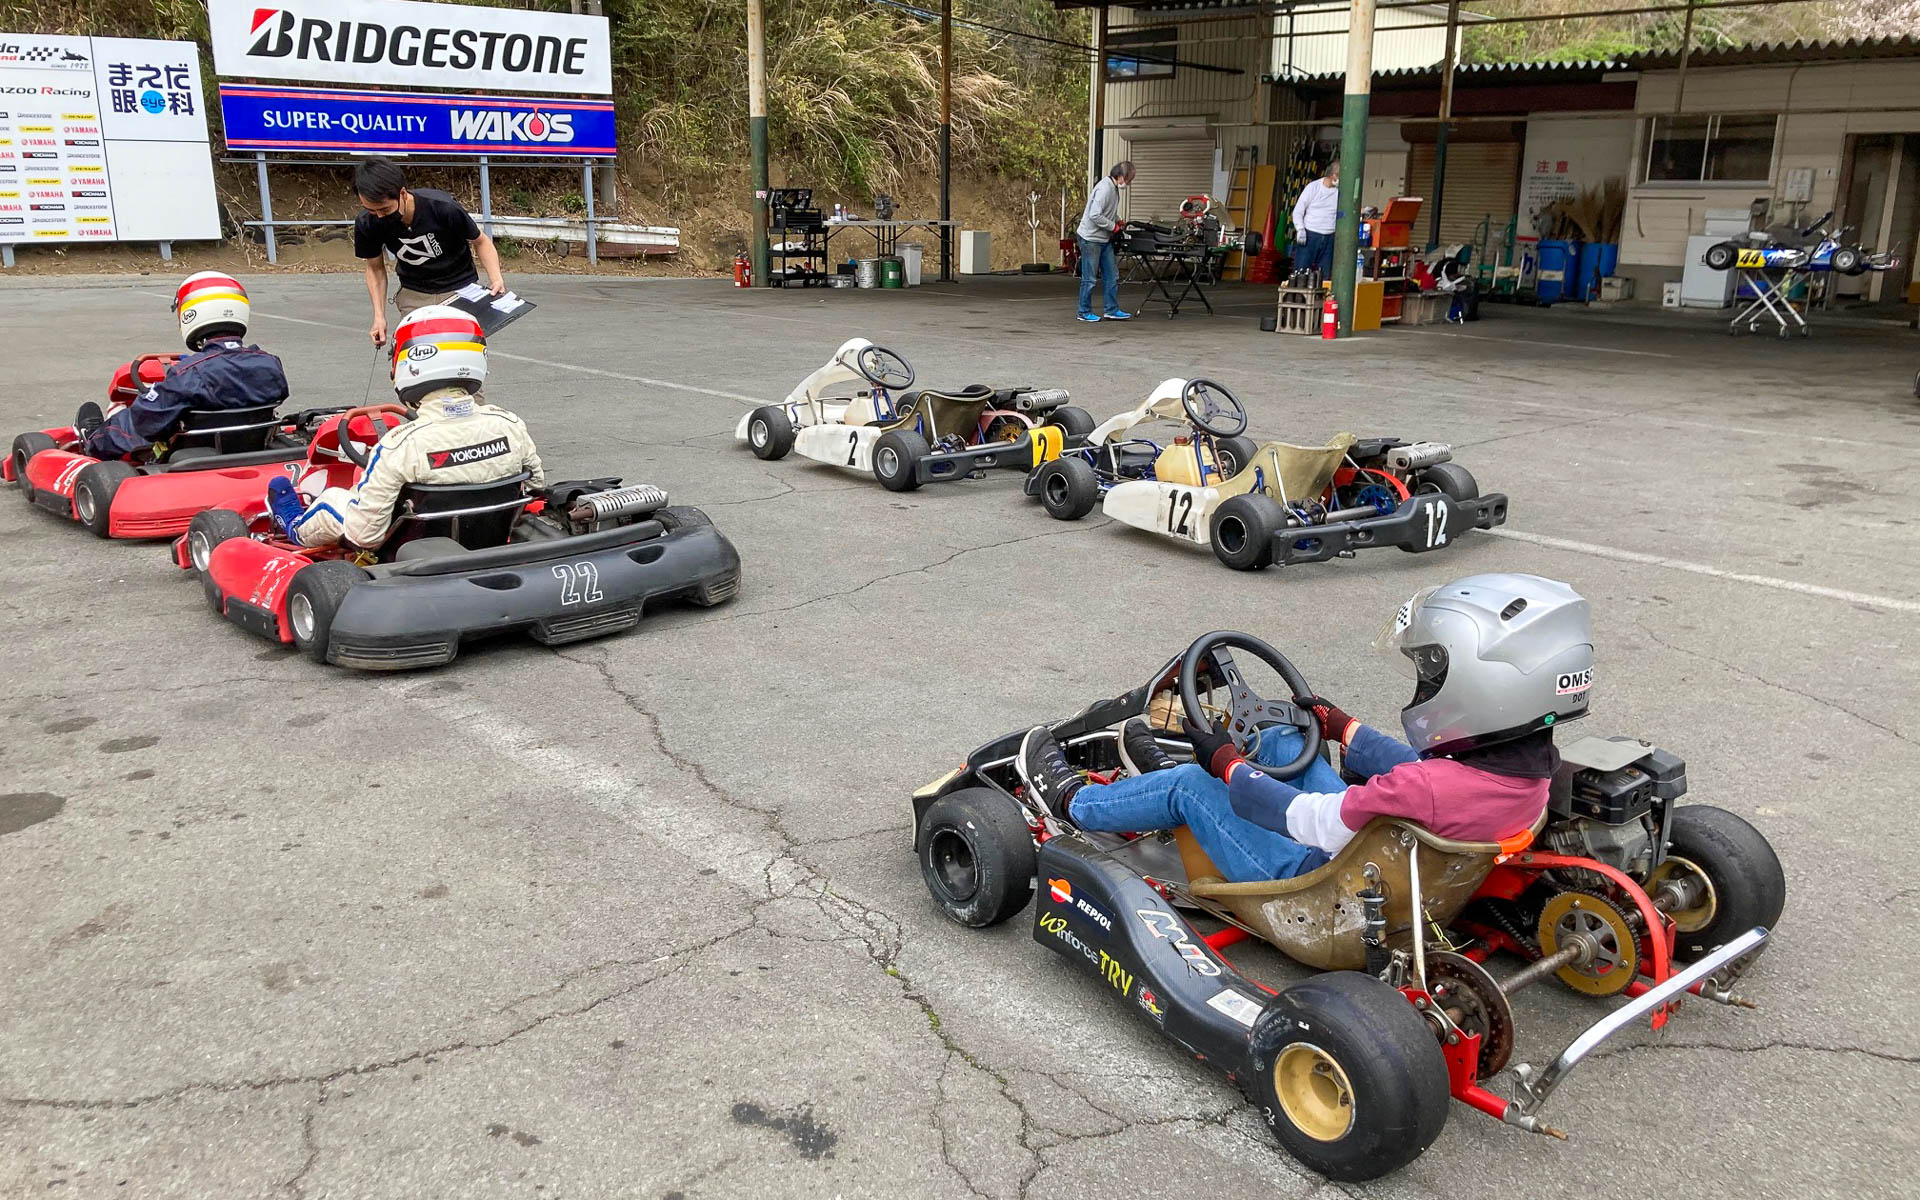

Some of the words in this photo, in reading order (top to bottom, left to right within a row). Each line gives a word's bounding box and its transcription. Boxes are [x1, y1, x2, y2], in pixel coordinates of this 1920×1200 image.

[246, 9, 588, 74] BRIDGESTONE
[108, 62, 191, 90] まえだ
[41, 86, 91, 98] Racing
[140, 98, 166, 108] eye
[263, 109, 428, 133] SUPER-QUALITY
[1740, 252, 1762, 264] 44
[409, 346, 433, 358] Arai
[450, 441, 508, 462] YOKOHAMA
[849, 431, 858, 466] 2
[1037, 433, 1048, 463] 2
[1167, 489, 1193, 534] 12
[1425, 500, 1448, 548] 12
[552, 561, 604, 606] 22
[1076, 898, 1112, 931] REPSOL
